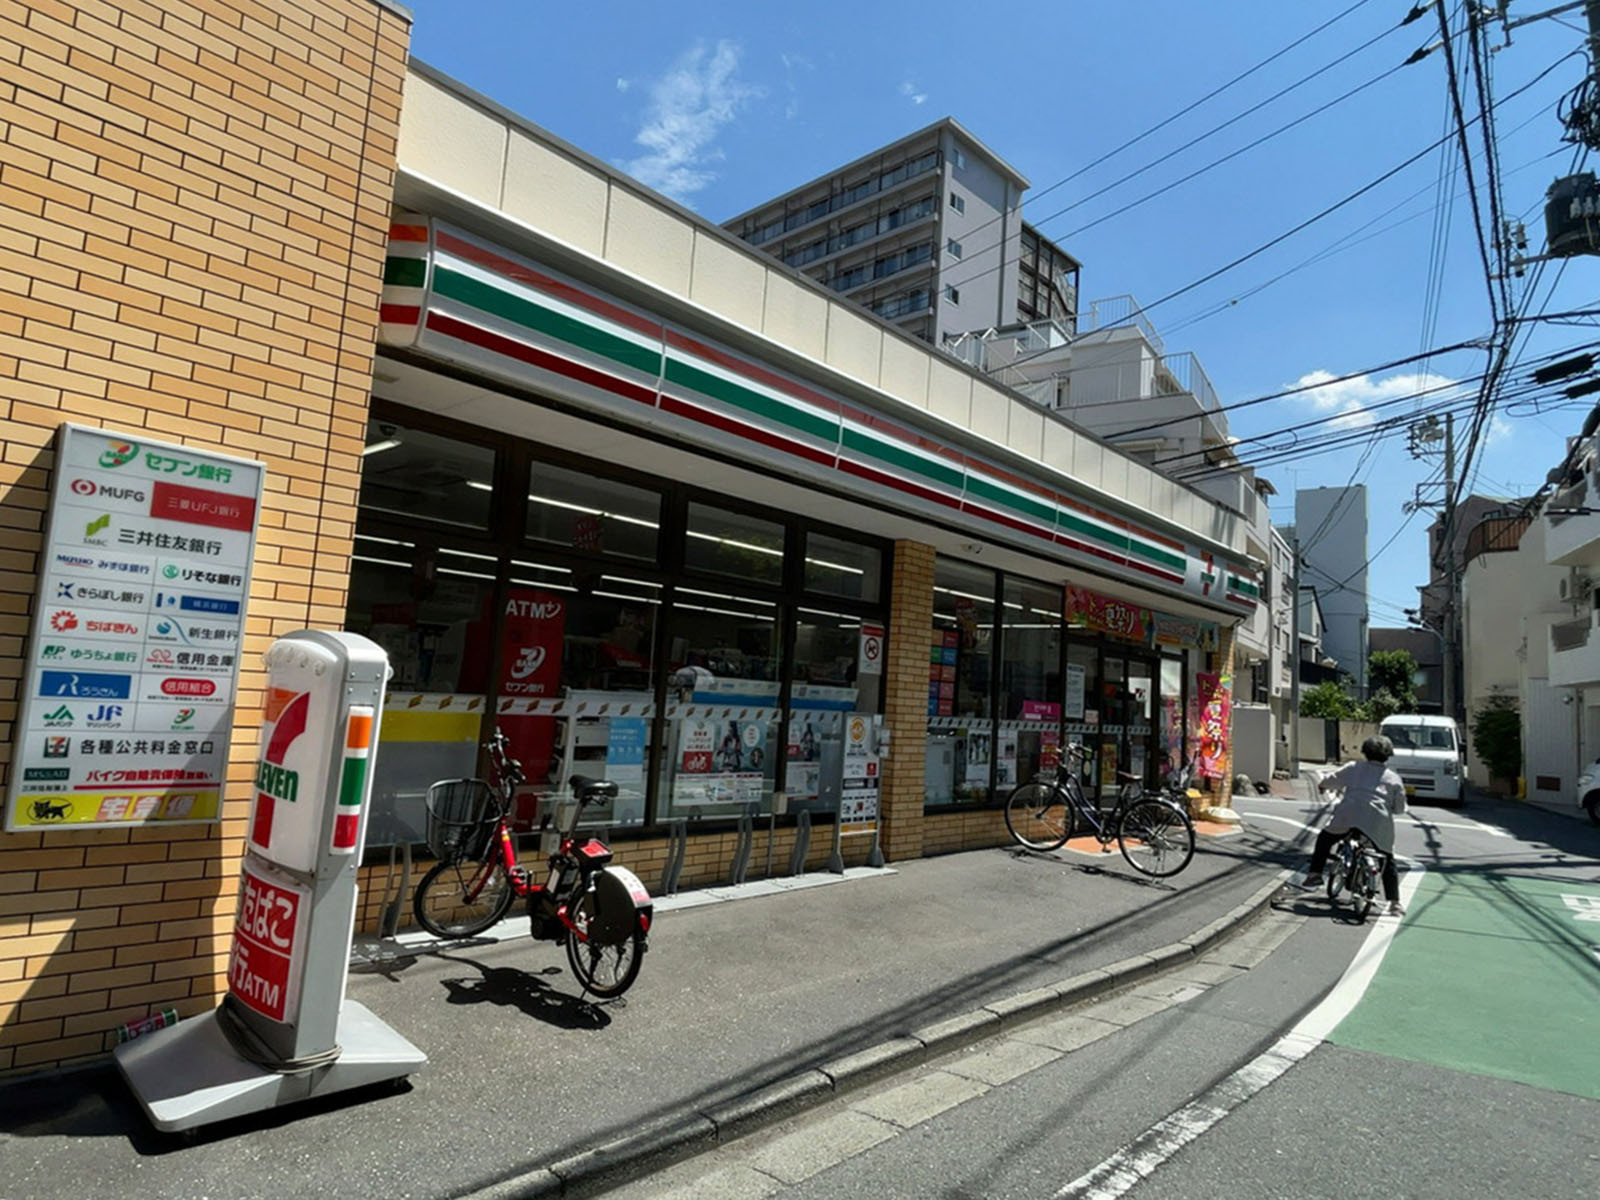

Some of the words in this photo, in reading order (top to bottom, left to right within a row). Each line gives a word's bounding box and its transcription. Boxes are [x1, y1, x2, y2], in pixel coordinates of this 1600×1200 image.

[145, 452, 233, 484] セブン銀行
[99, 485, 146, 503] MUFG
[168, 496, 240, 518] 三菱UFJ銀行
[118, 528, 223, 556] 三井住友銀行
[97, 558, 150, 575] みずほ銀行
[182, 568, 242, 587] りそな銀行
[76, 586, 145, 604] きらぼし銀行
[188, 626, 239, 641] 新生銀行
[70, 649, 137, 663] ゆうちょ銀行
[176, 652, 235, 667] 信用金庫
[164, 681, 214, 694] 信用組合
[505, 682, 544, 693] セブン銀行
[80, 739, 214, 755] 各種公共料金窓口
[239, 878, 293, 948] たばこ
